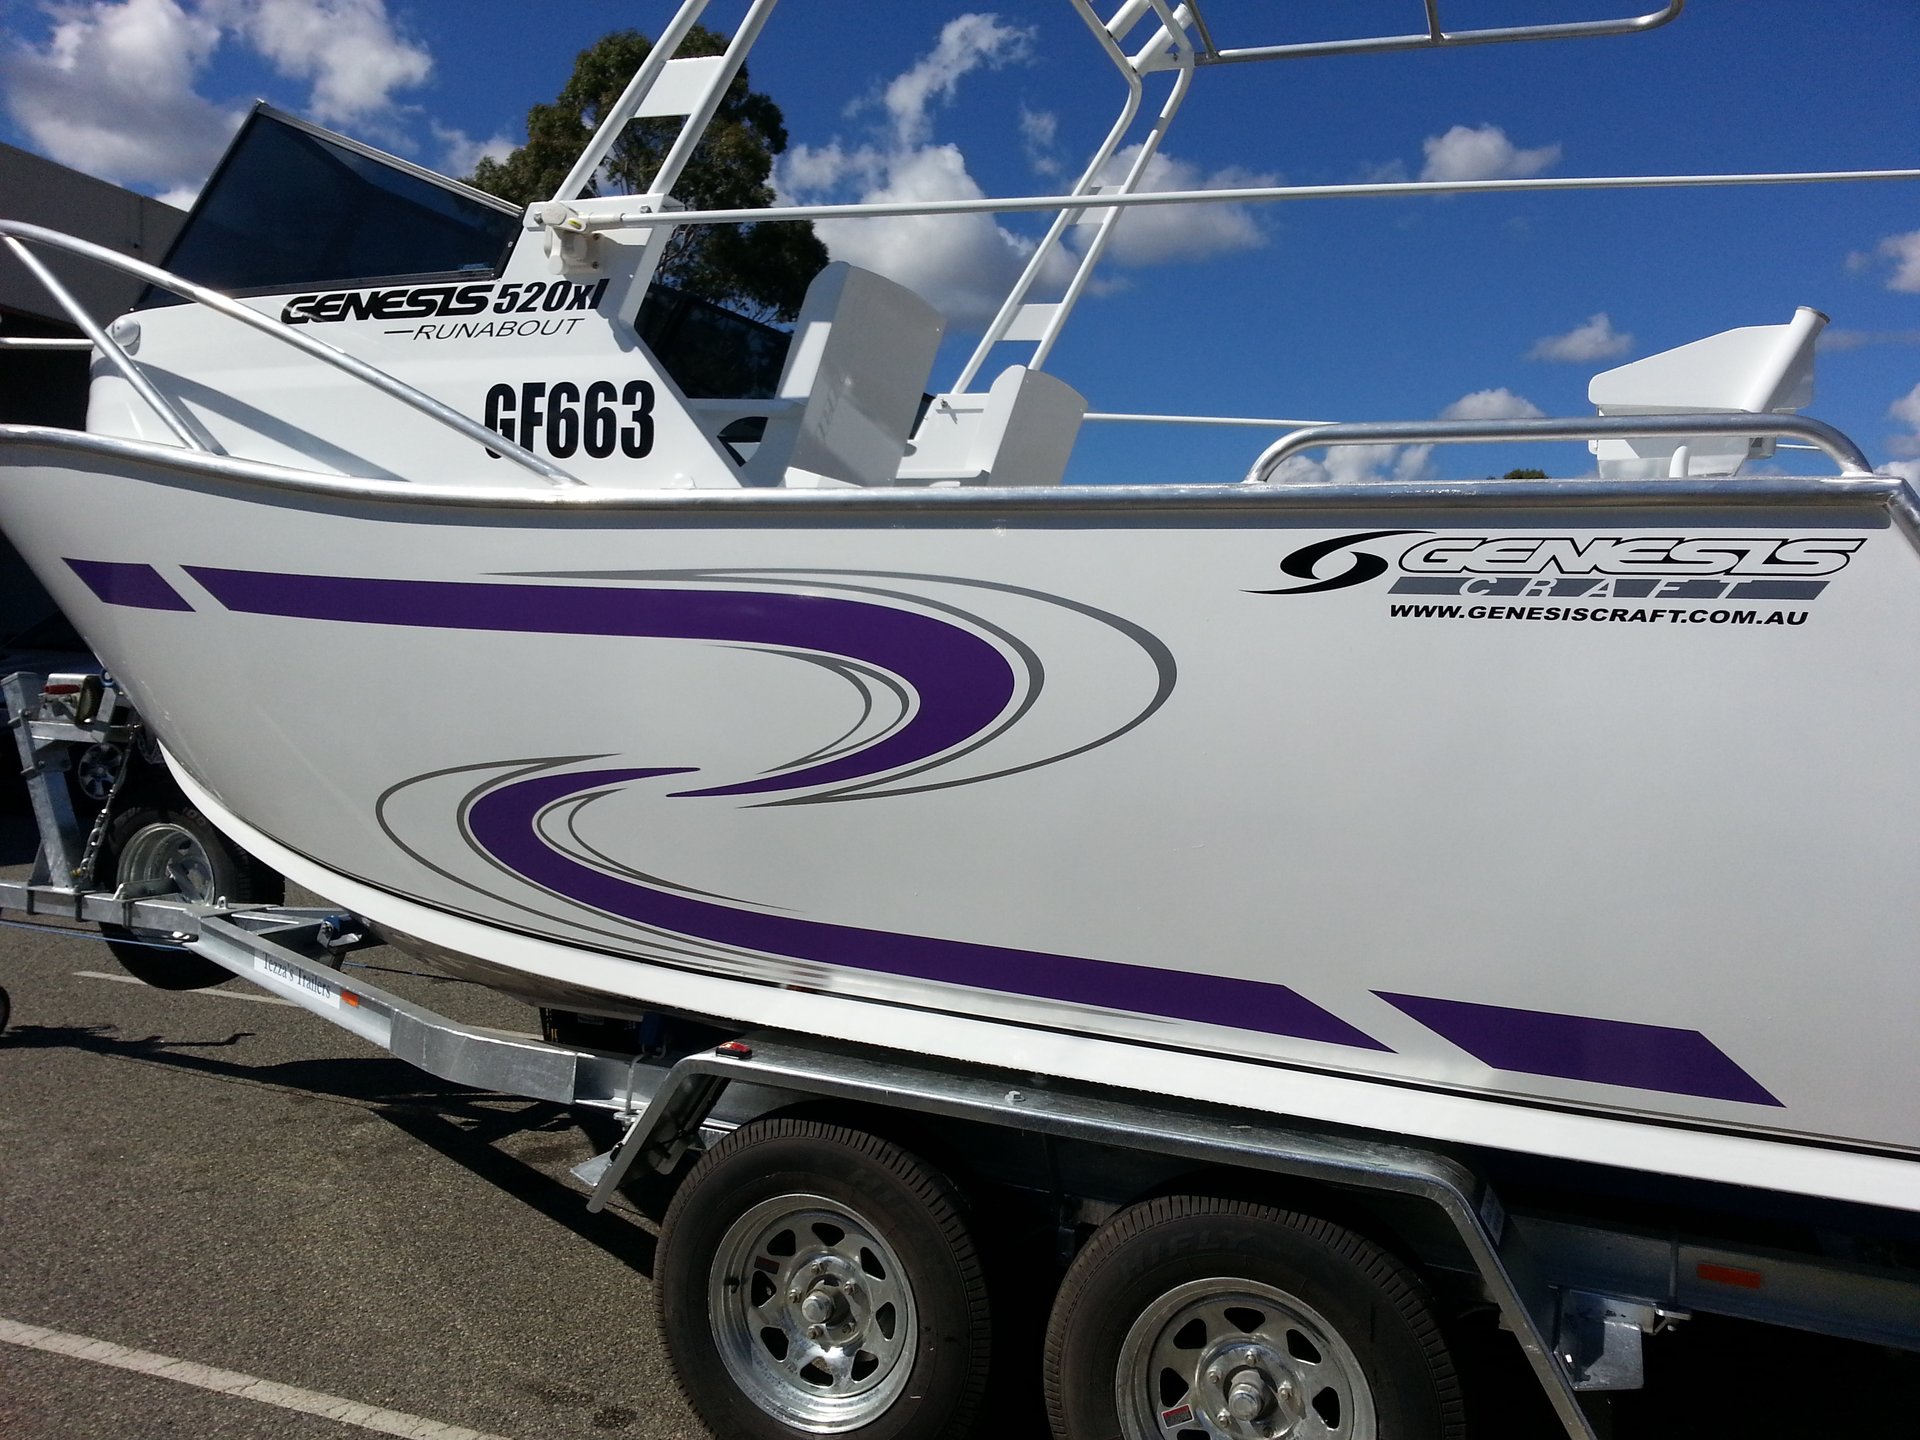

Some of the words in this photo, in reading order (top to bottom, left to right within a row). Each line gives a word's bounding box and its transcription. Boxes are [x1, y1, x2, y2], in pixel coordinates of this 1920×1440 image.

[281, 285, 494, 324] GENESIS
[412, 318, 584, 341] RUNABOUT
[484, 379, 656, 459] GF663
[1398, 537, 1868, 577] GENESIS
[1459, 577, 1752, 600] CRAFT
[1390, 605, 1809, 626] WWW.GENESISCRAFT.COM.AU
[262, 952, 294, 981] Tezza's
[295, 966, 331, 999] Trailers
